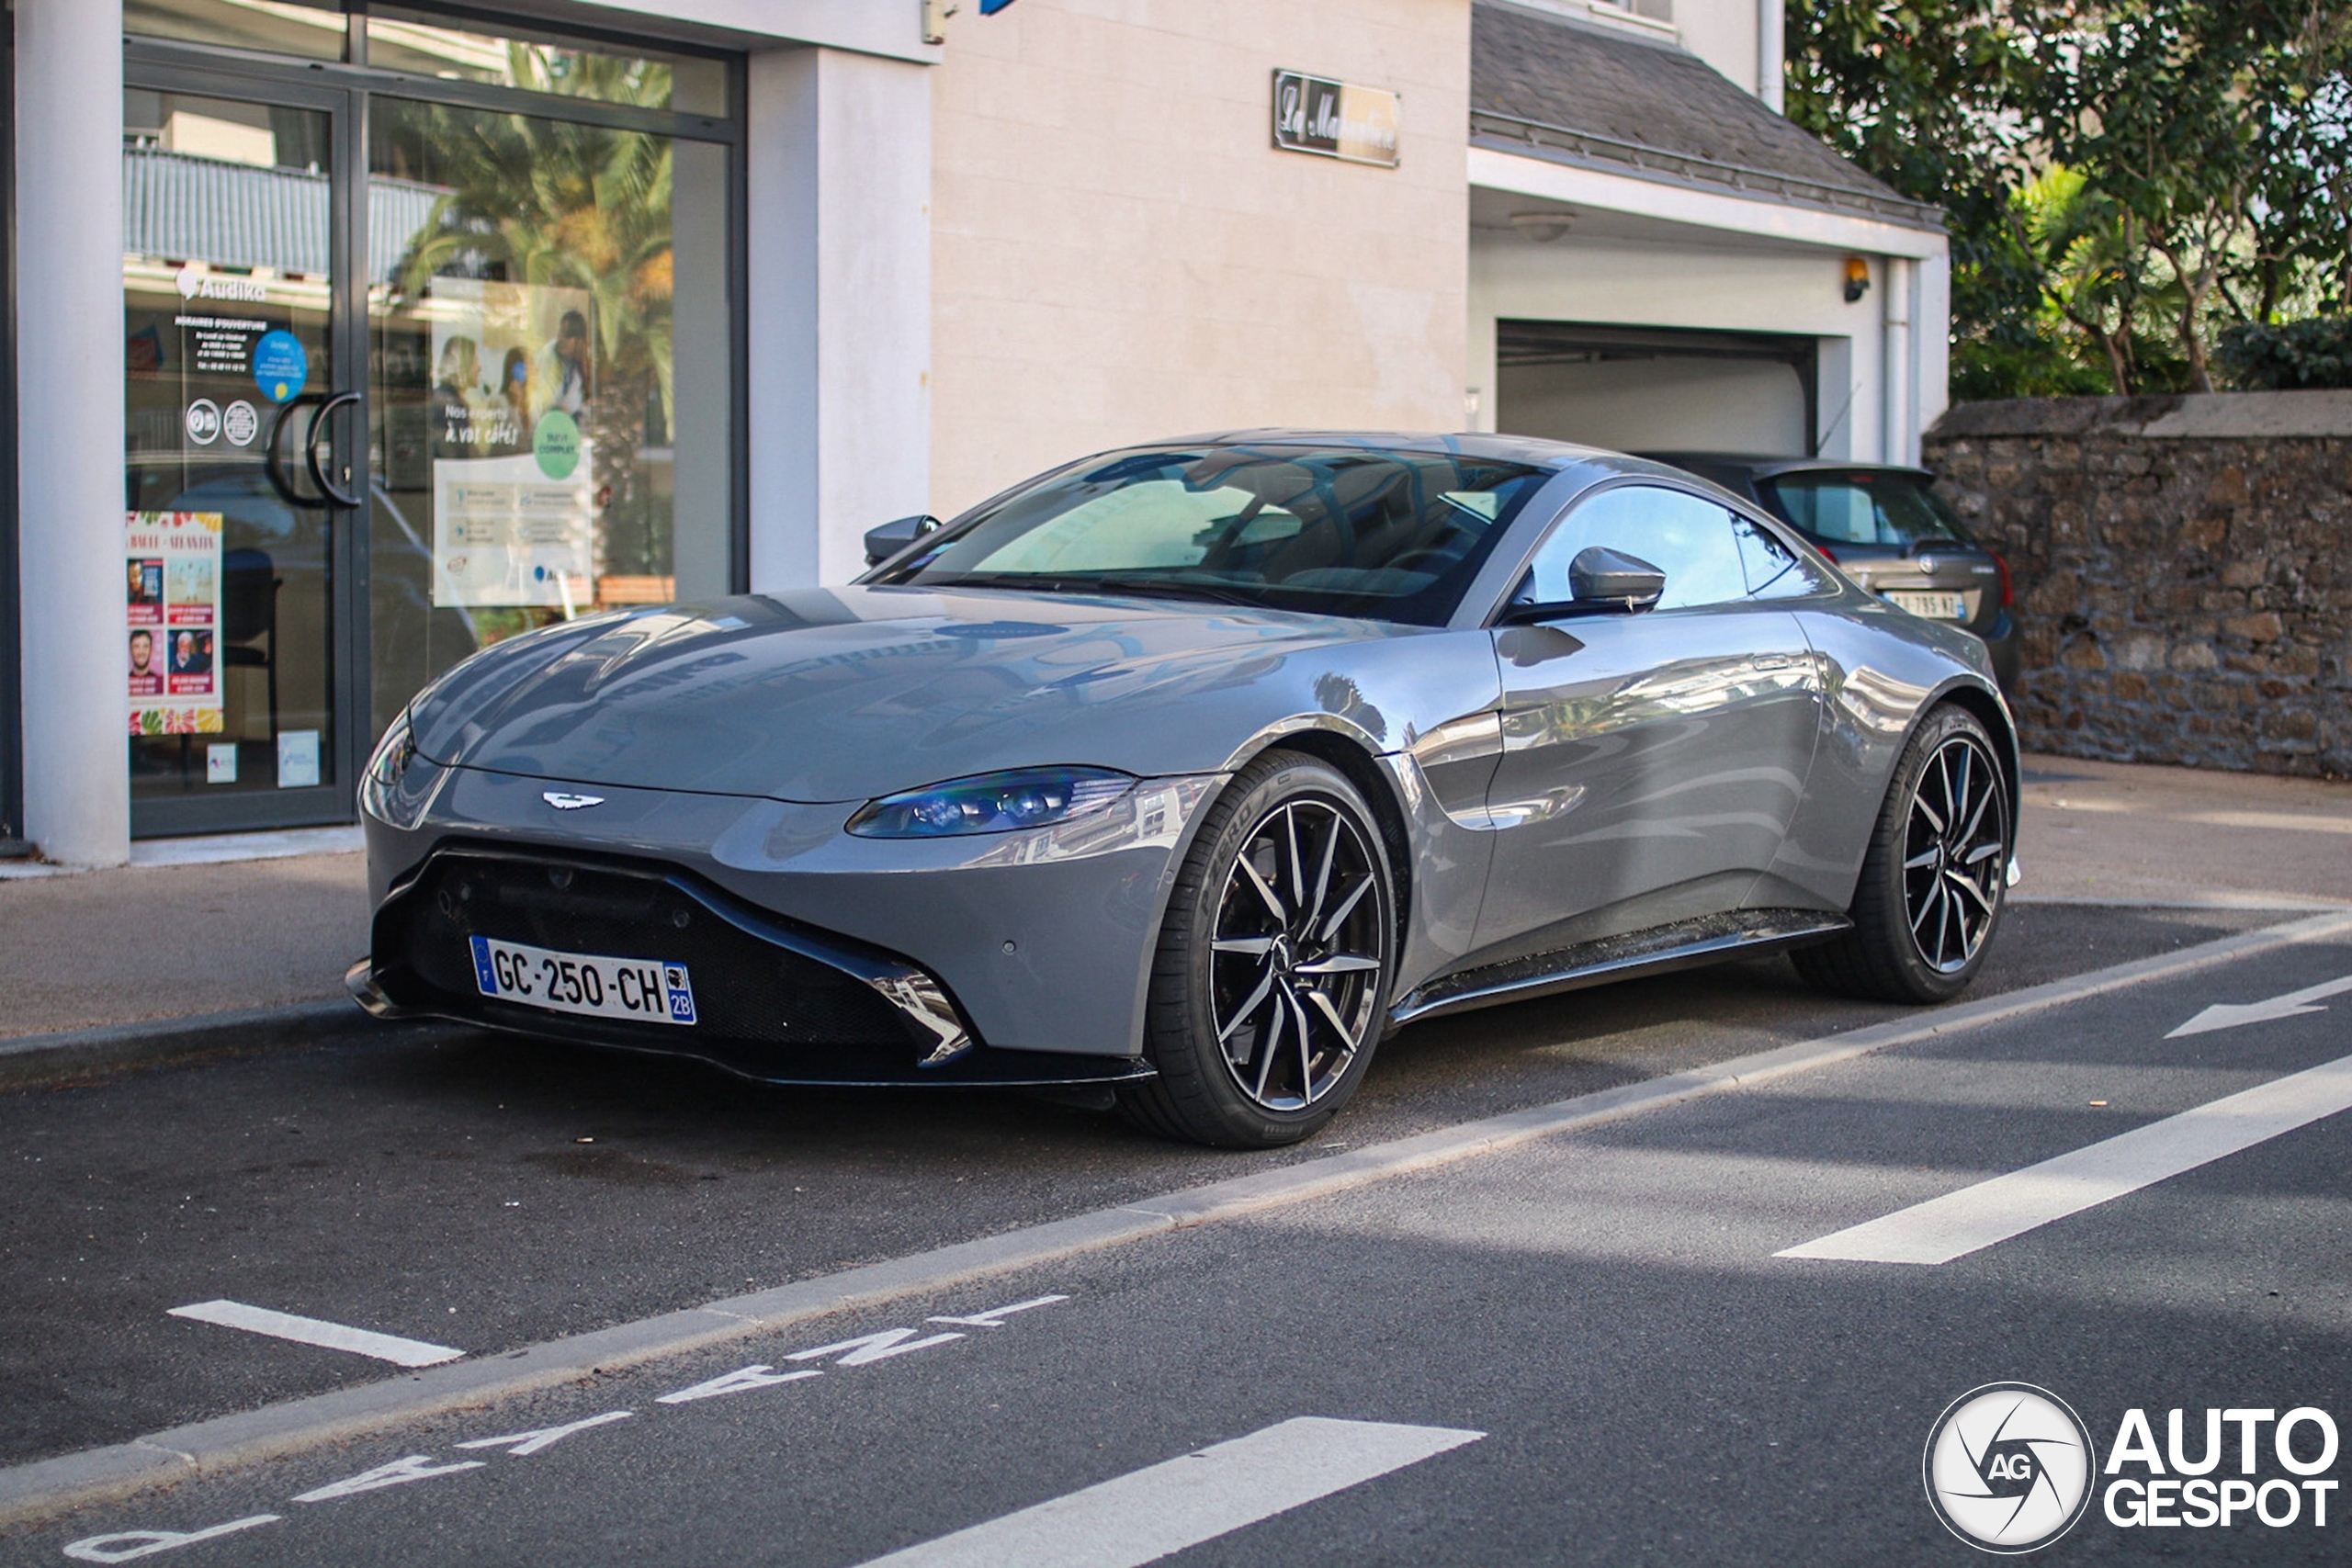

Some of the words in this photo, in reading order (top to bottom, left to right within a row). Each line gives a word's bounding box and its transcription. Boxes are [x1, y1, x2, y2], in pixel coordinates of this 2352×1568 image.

[199, 279, 266, 301] Audika
[445, 404, 468, 418] Nos
[671, 995, 691, 1015] 2B
